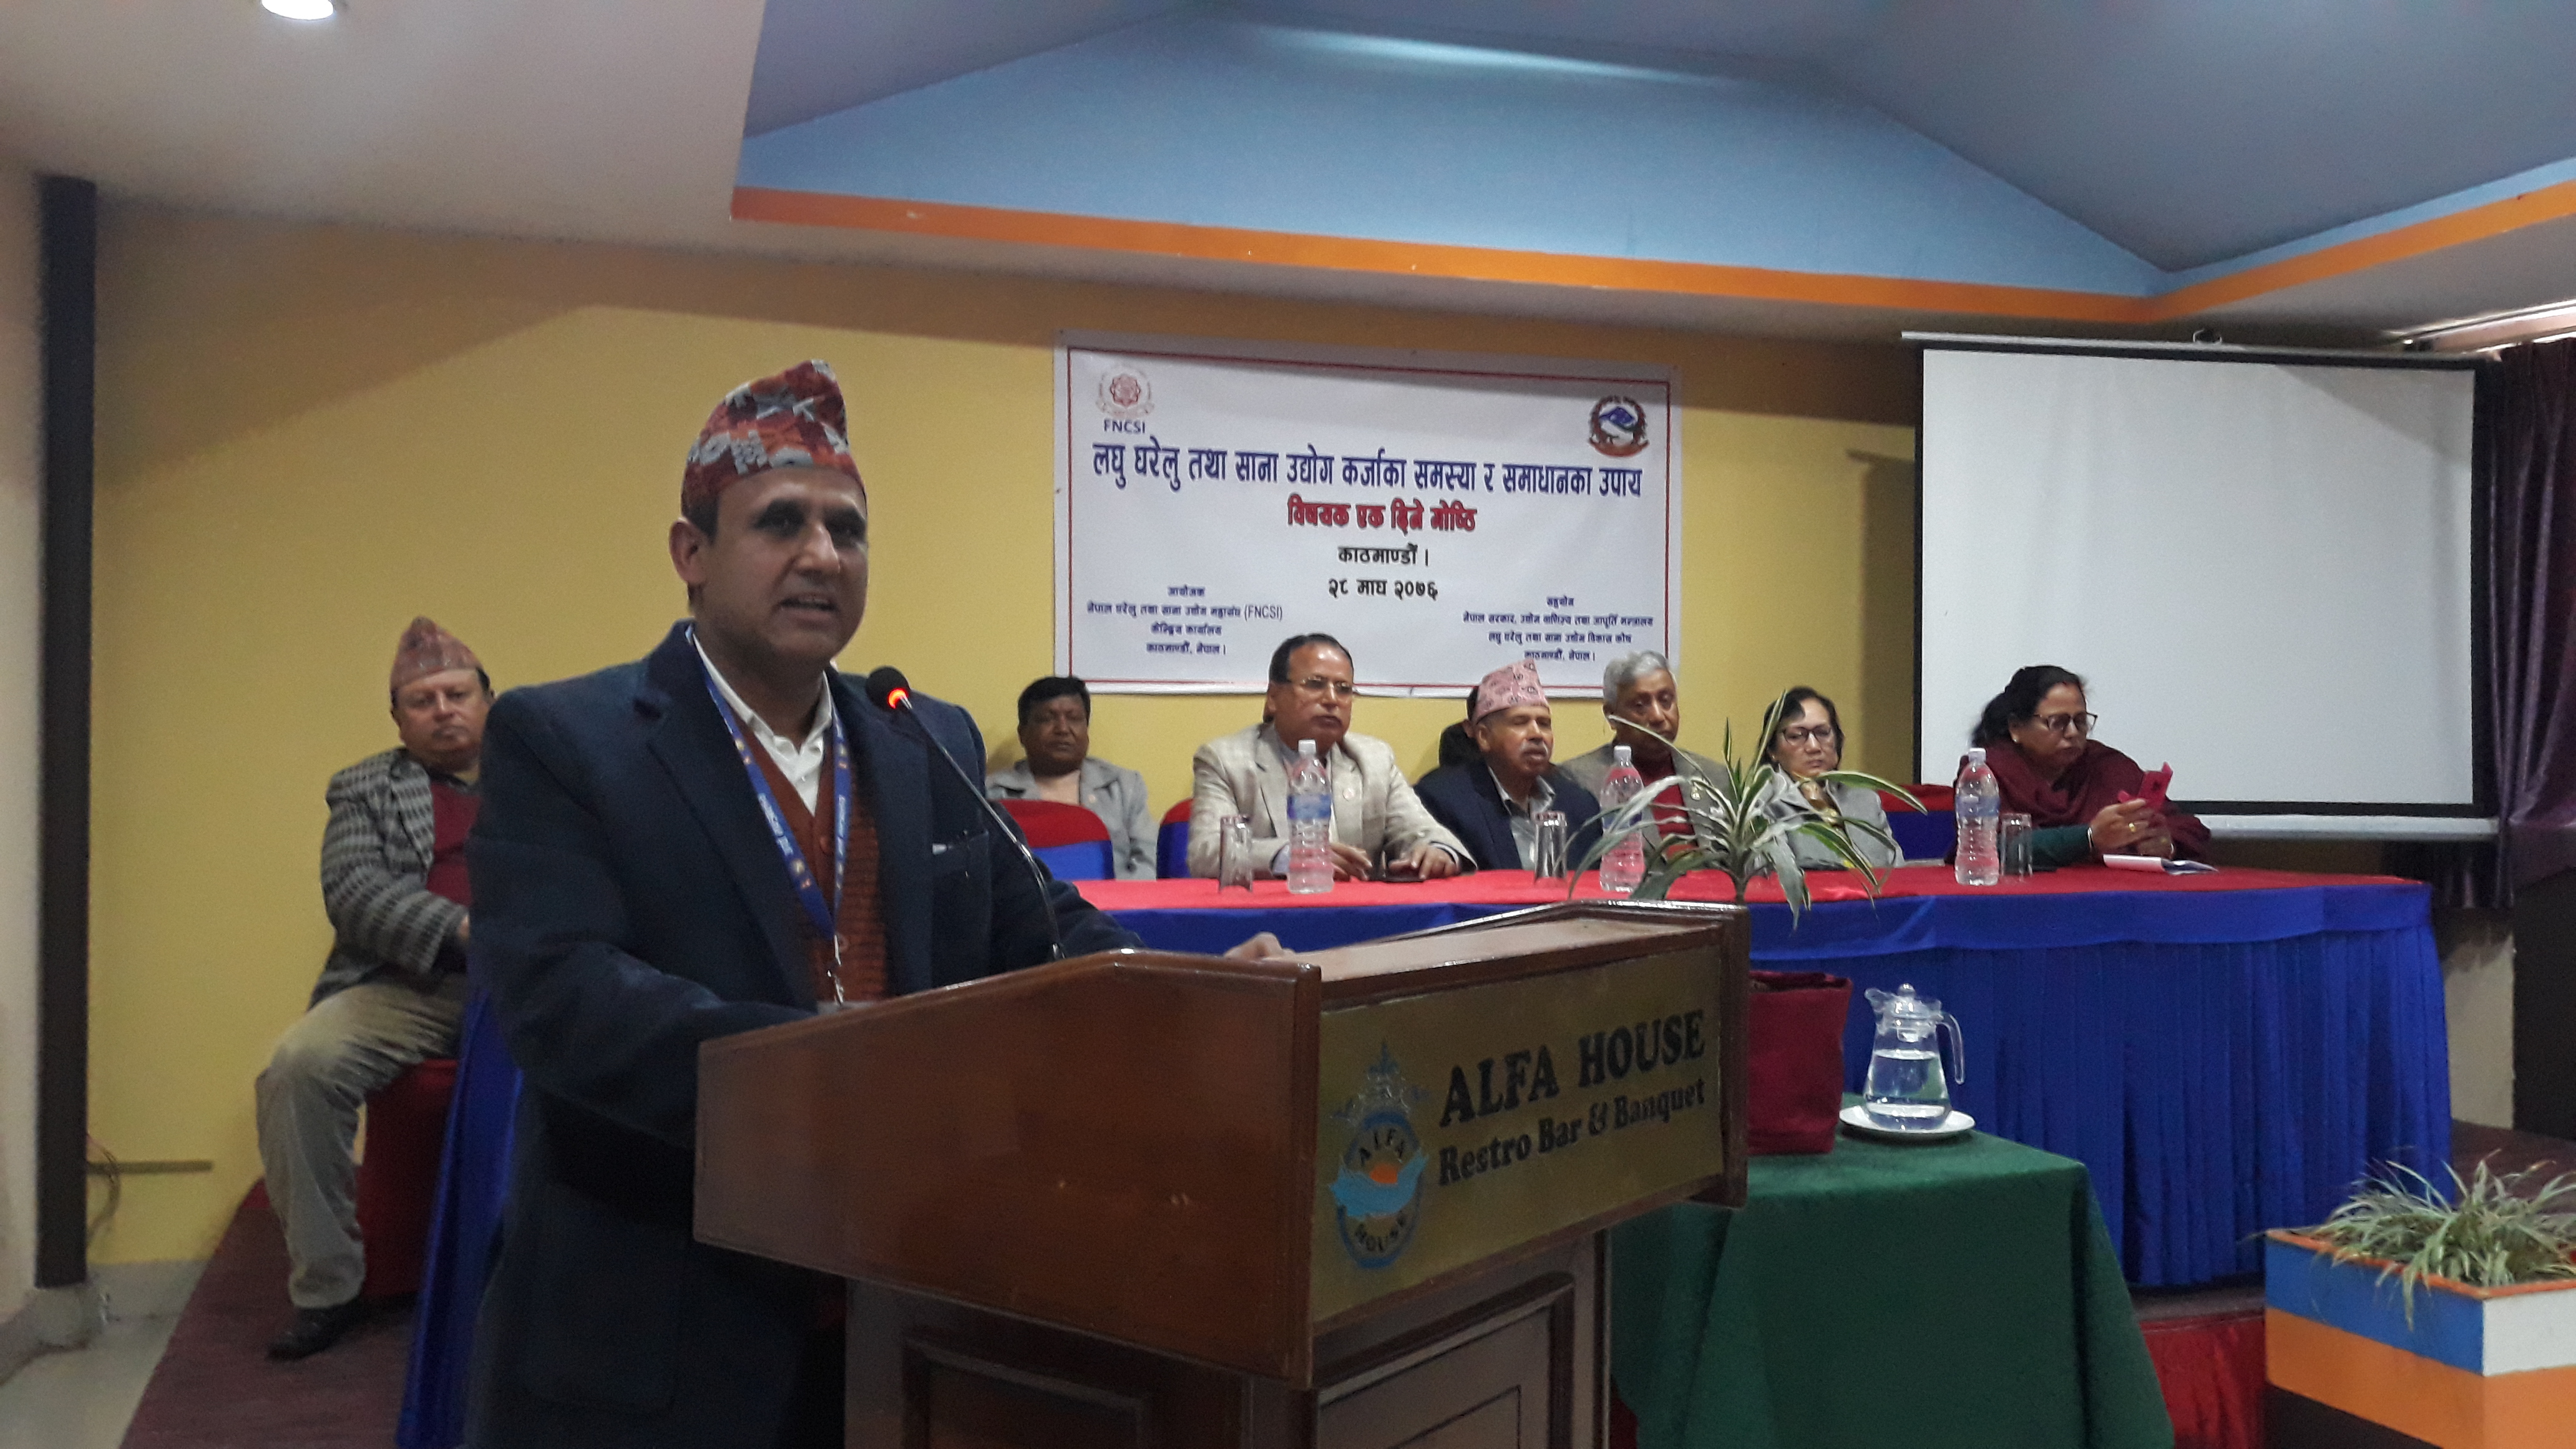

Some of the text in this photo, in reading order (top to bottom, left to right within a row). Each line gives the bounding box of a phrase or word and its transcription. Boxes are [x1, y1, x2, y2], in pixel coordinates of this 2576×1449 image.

[1103, 419, 1145, 434] FNCSI
[1093, 435, 1642, 497] लघु घरेलु तथा साना उद्योग कर्जाका समस्या र समाधानका उपाय
[1287, 493, 1351, 527] विषयक
[1356, 504, 1385, 529] एक
[1329, 578, 1438, 600] २८ माघ २०७६
[1088, 600, 1112, 614] नेपाल
[1244, 604, 1283, 622] (FNCSI)
[1439, 1010, 1705, 1127] ALFA HOUSE
[1438, 1078, 1705, 1186] Restro Bar & Banquet
